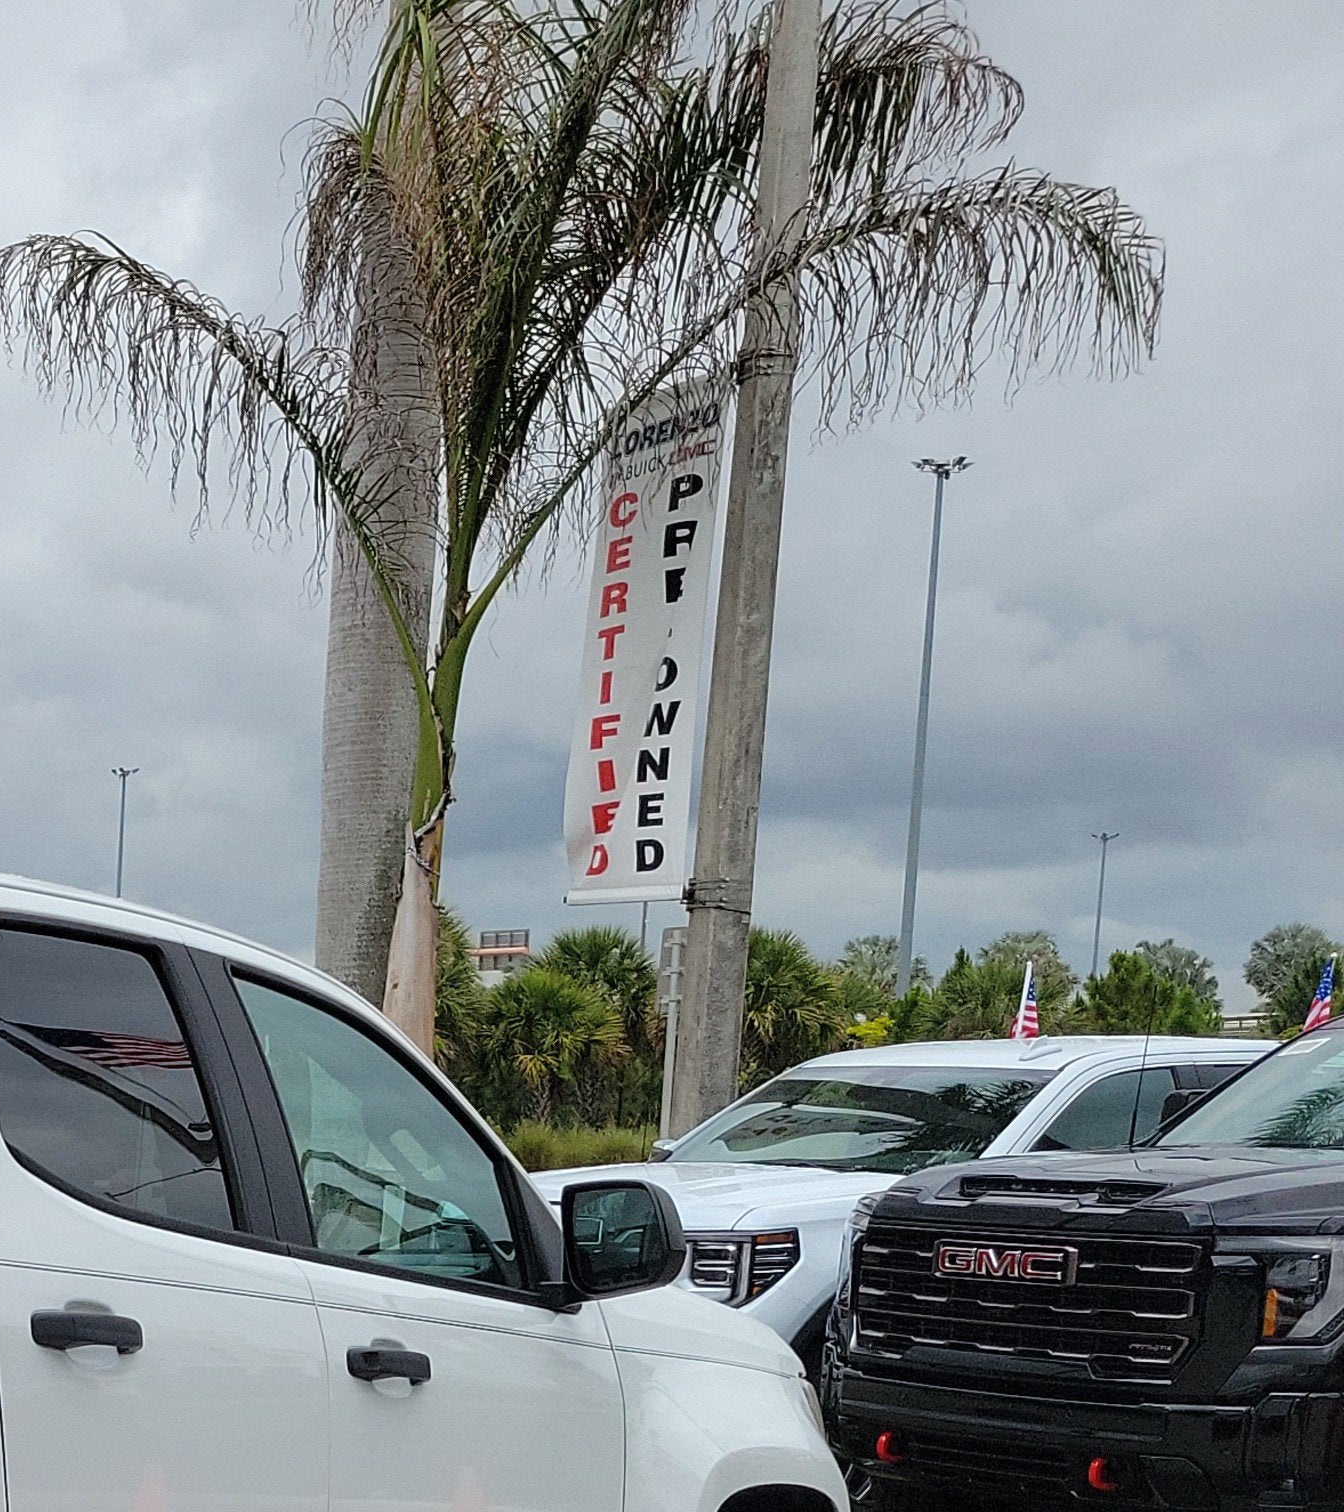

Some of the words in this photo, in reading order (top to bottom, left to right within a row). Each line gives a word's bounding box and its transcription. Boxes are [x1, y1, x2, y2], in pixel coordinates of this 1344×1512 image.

[625, 453, 666, 481] BUICK
[585, 491, 639, 877] CERTIFIED
[938, 1246, 1064, 1281] GMC
